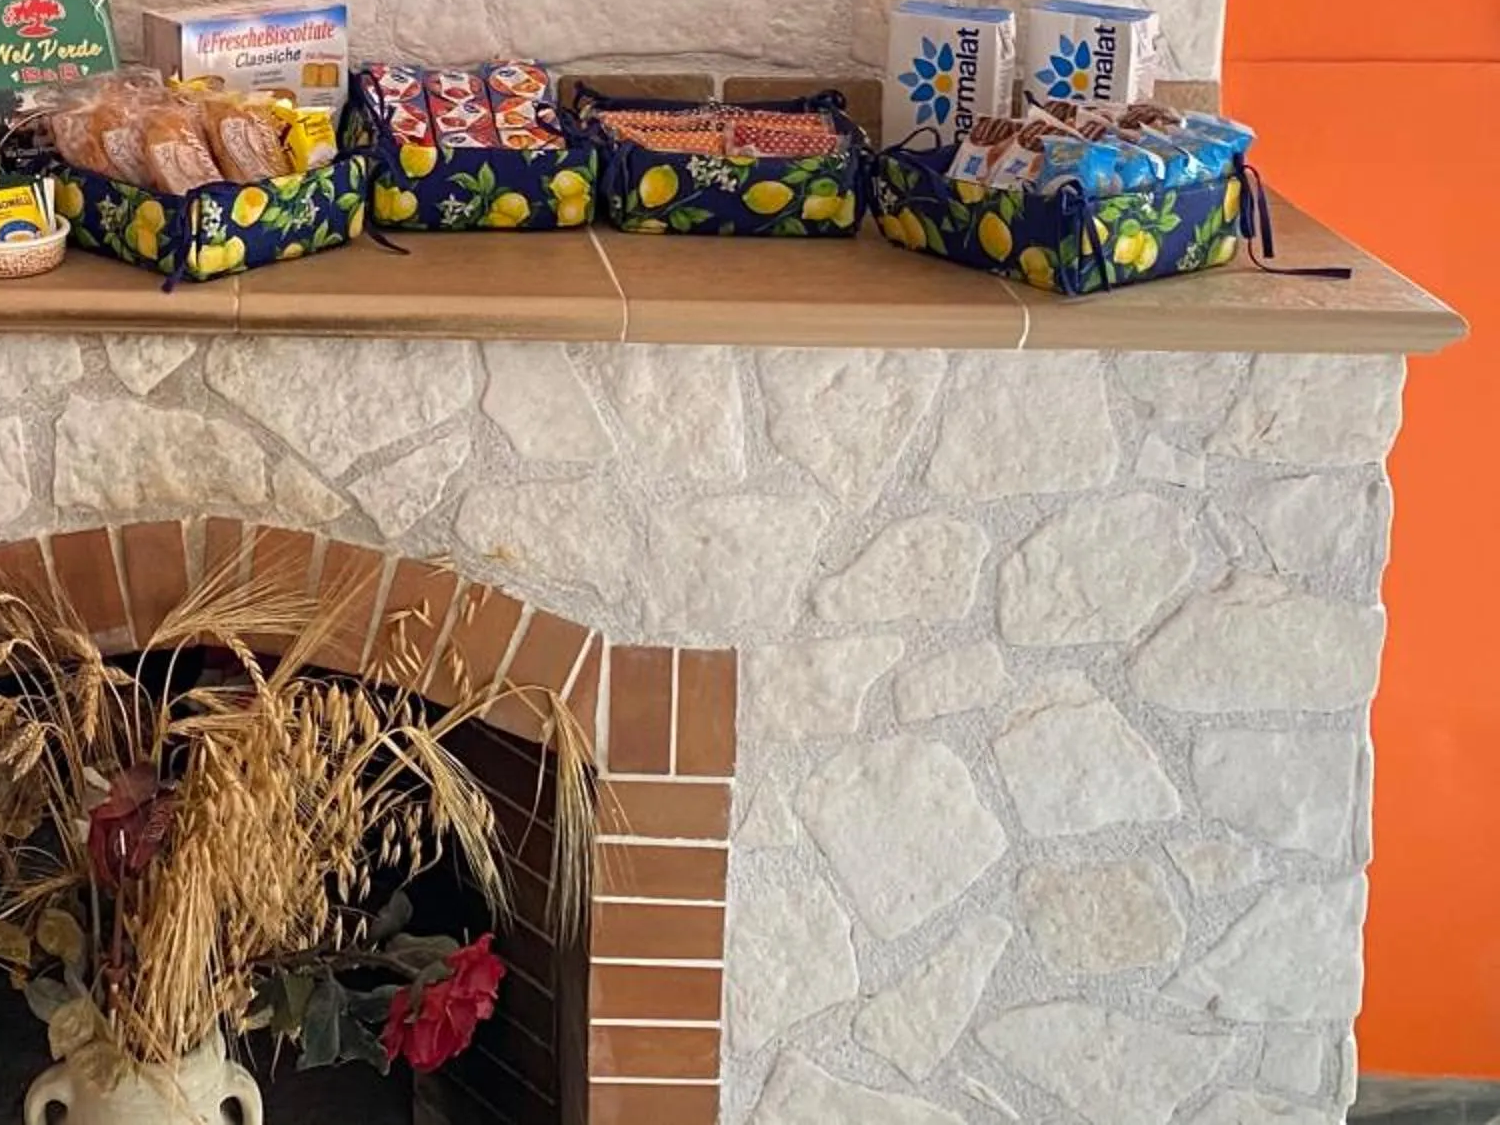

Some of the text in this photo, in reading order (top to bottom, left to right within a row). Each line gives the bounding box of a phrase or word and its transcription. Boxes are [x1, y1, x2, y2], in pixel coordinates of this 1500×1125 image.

[37, 38, 103, 62] Verde
[235, 46, 301, 68] Classiche
[1092, 24, 1117, 100] malat
